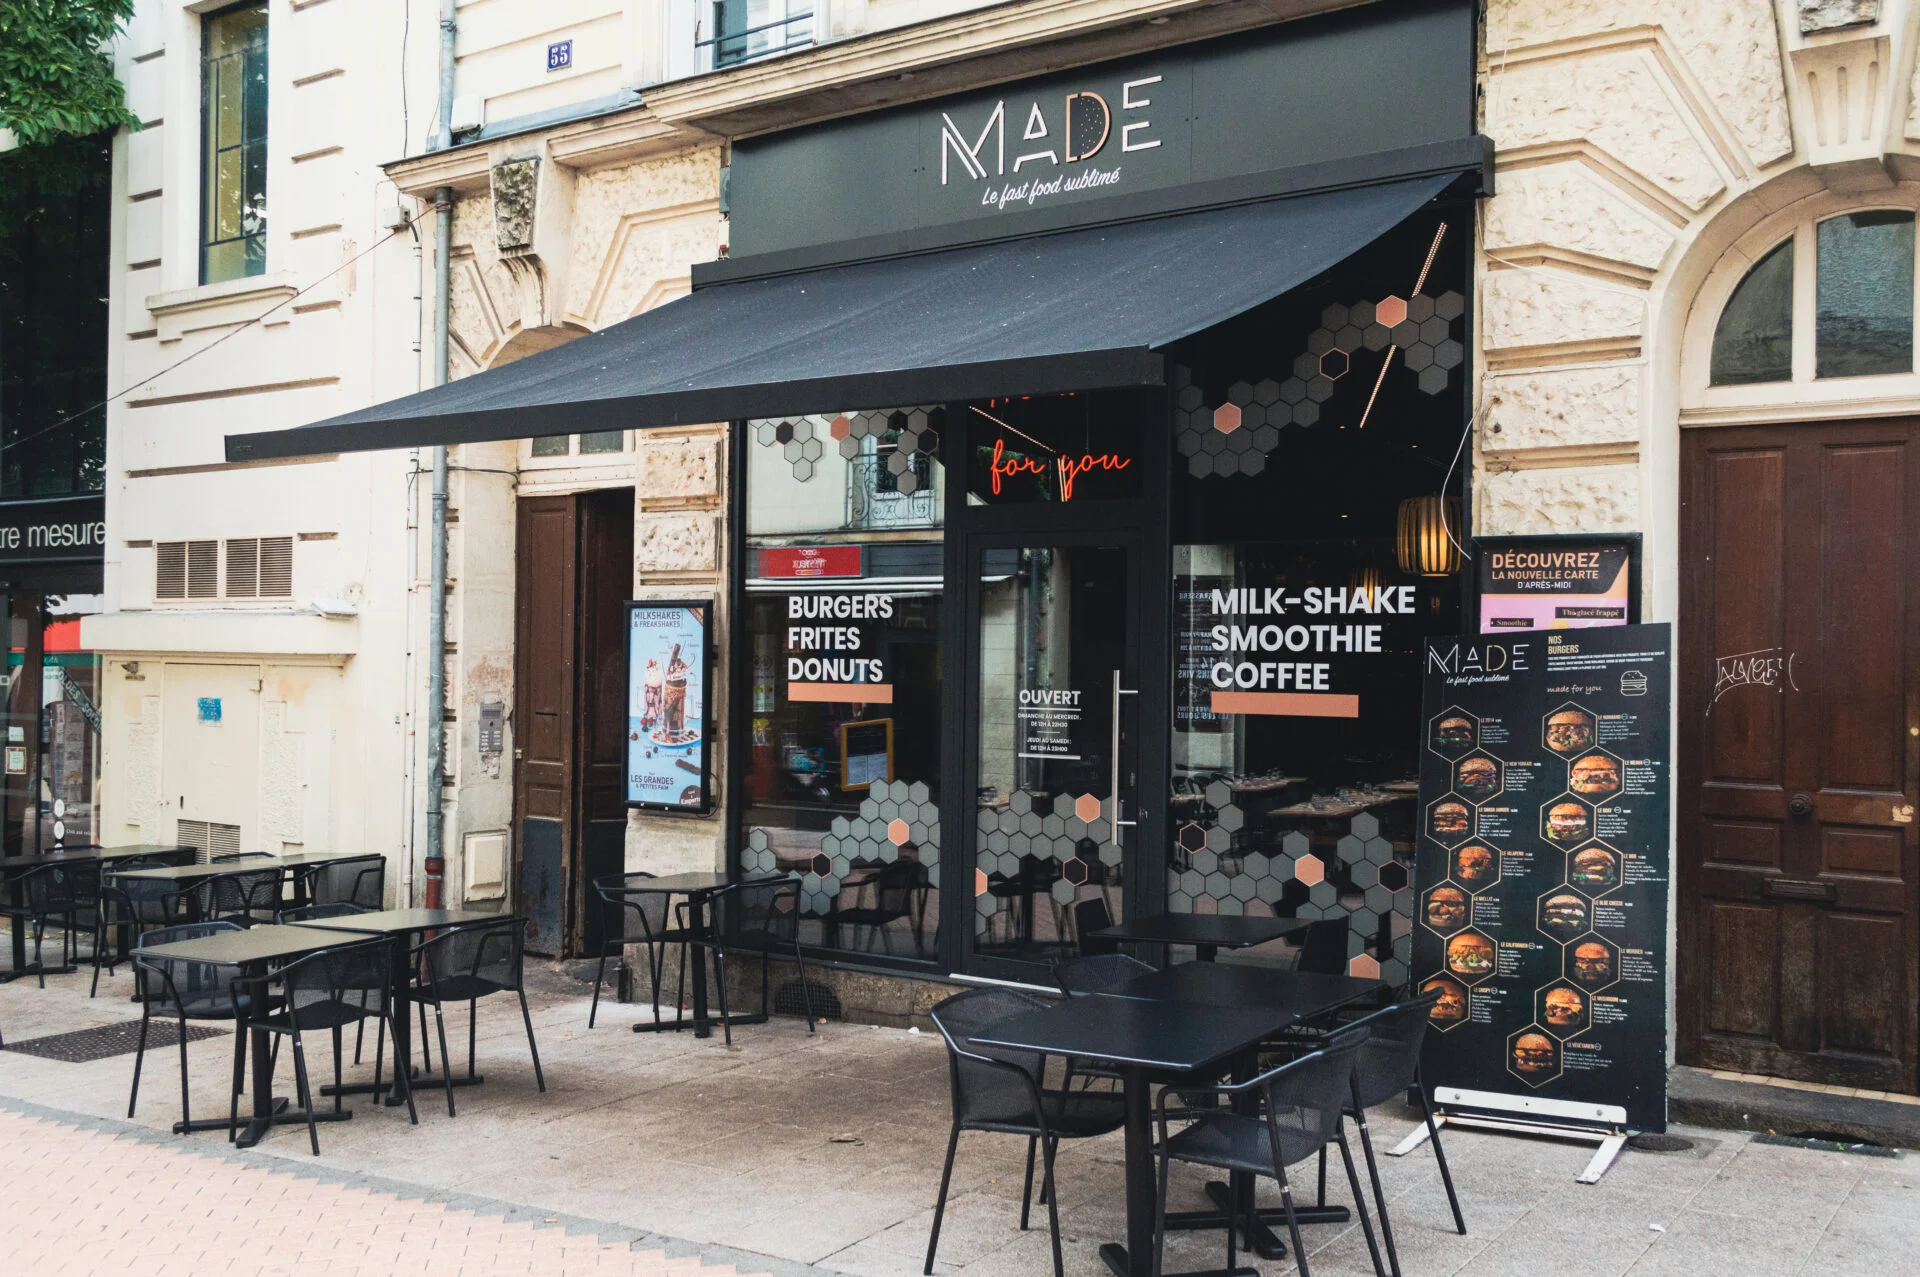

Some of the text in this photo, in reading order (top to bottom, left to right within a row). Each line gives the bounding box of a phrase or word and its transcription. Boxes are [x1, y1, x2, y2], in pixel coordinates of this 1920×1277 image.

[551, 45, 568, 66] 55
[941, 75, 1163, 186] MADE
[982, 167, 1121, 210] Le fast food sublimé
[990, 438, 1132, 500] for you
[27, 521, 106, 548] mesure
[1492, 549, 1600, 569] DÉCOUVREZ
[1492, 569, 1599, 580] LA NOUVELLE CARTE
[788, 595, 893, 619] BURGERS
[1211, 586, 1416, 615] MILK-SHAKE
[634, 611, 681, 620] MILKSHAKES
[1496, 619, 1528, 627] Smoothie
[788, 626, 861, 650] FRITES
[1211, 624, 1382, 653] SMOOTHIE
[1548, 635, 1562, 645] NOS
[1548, 644, 1580, 654] BURGERS
[787, 658, 884, 683] DONUTS
[1428, 643, 1530, 675] MADE
[1211, 661, 1330, 691] COFFEE
[1018, 689, 1082, 706] OUVERT
[1547, 684, 1602, 695] made for you
[630, 774, 674, 786] LES GRANDES
